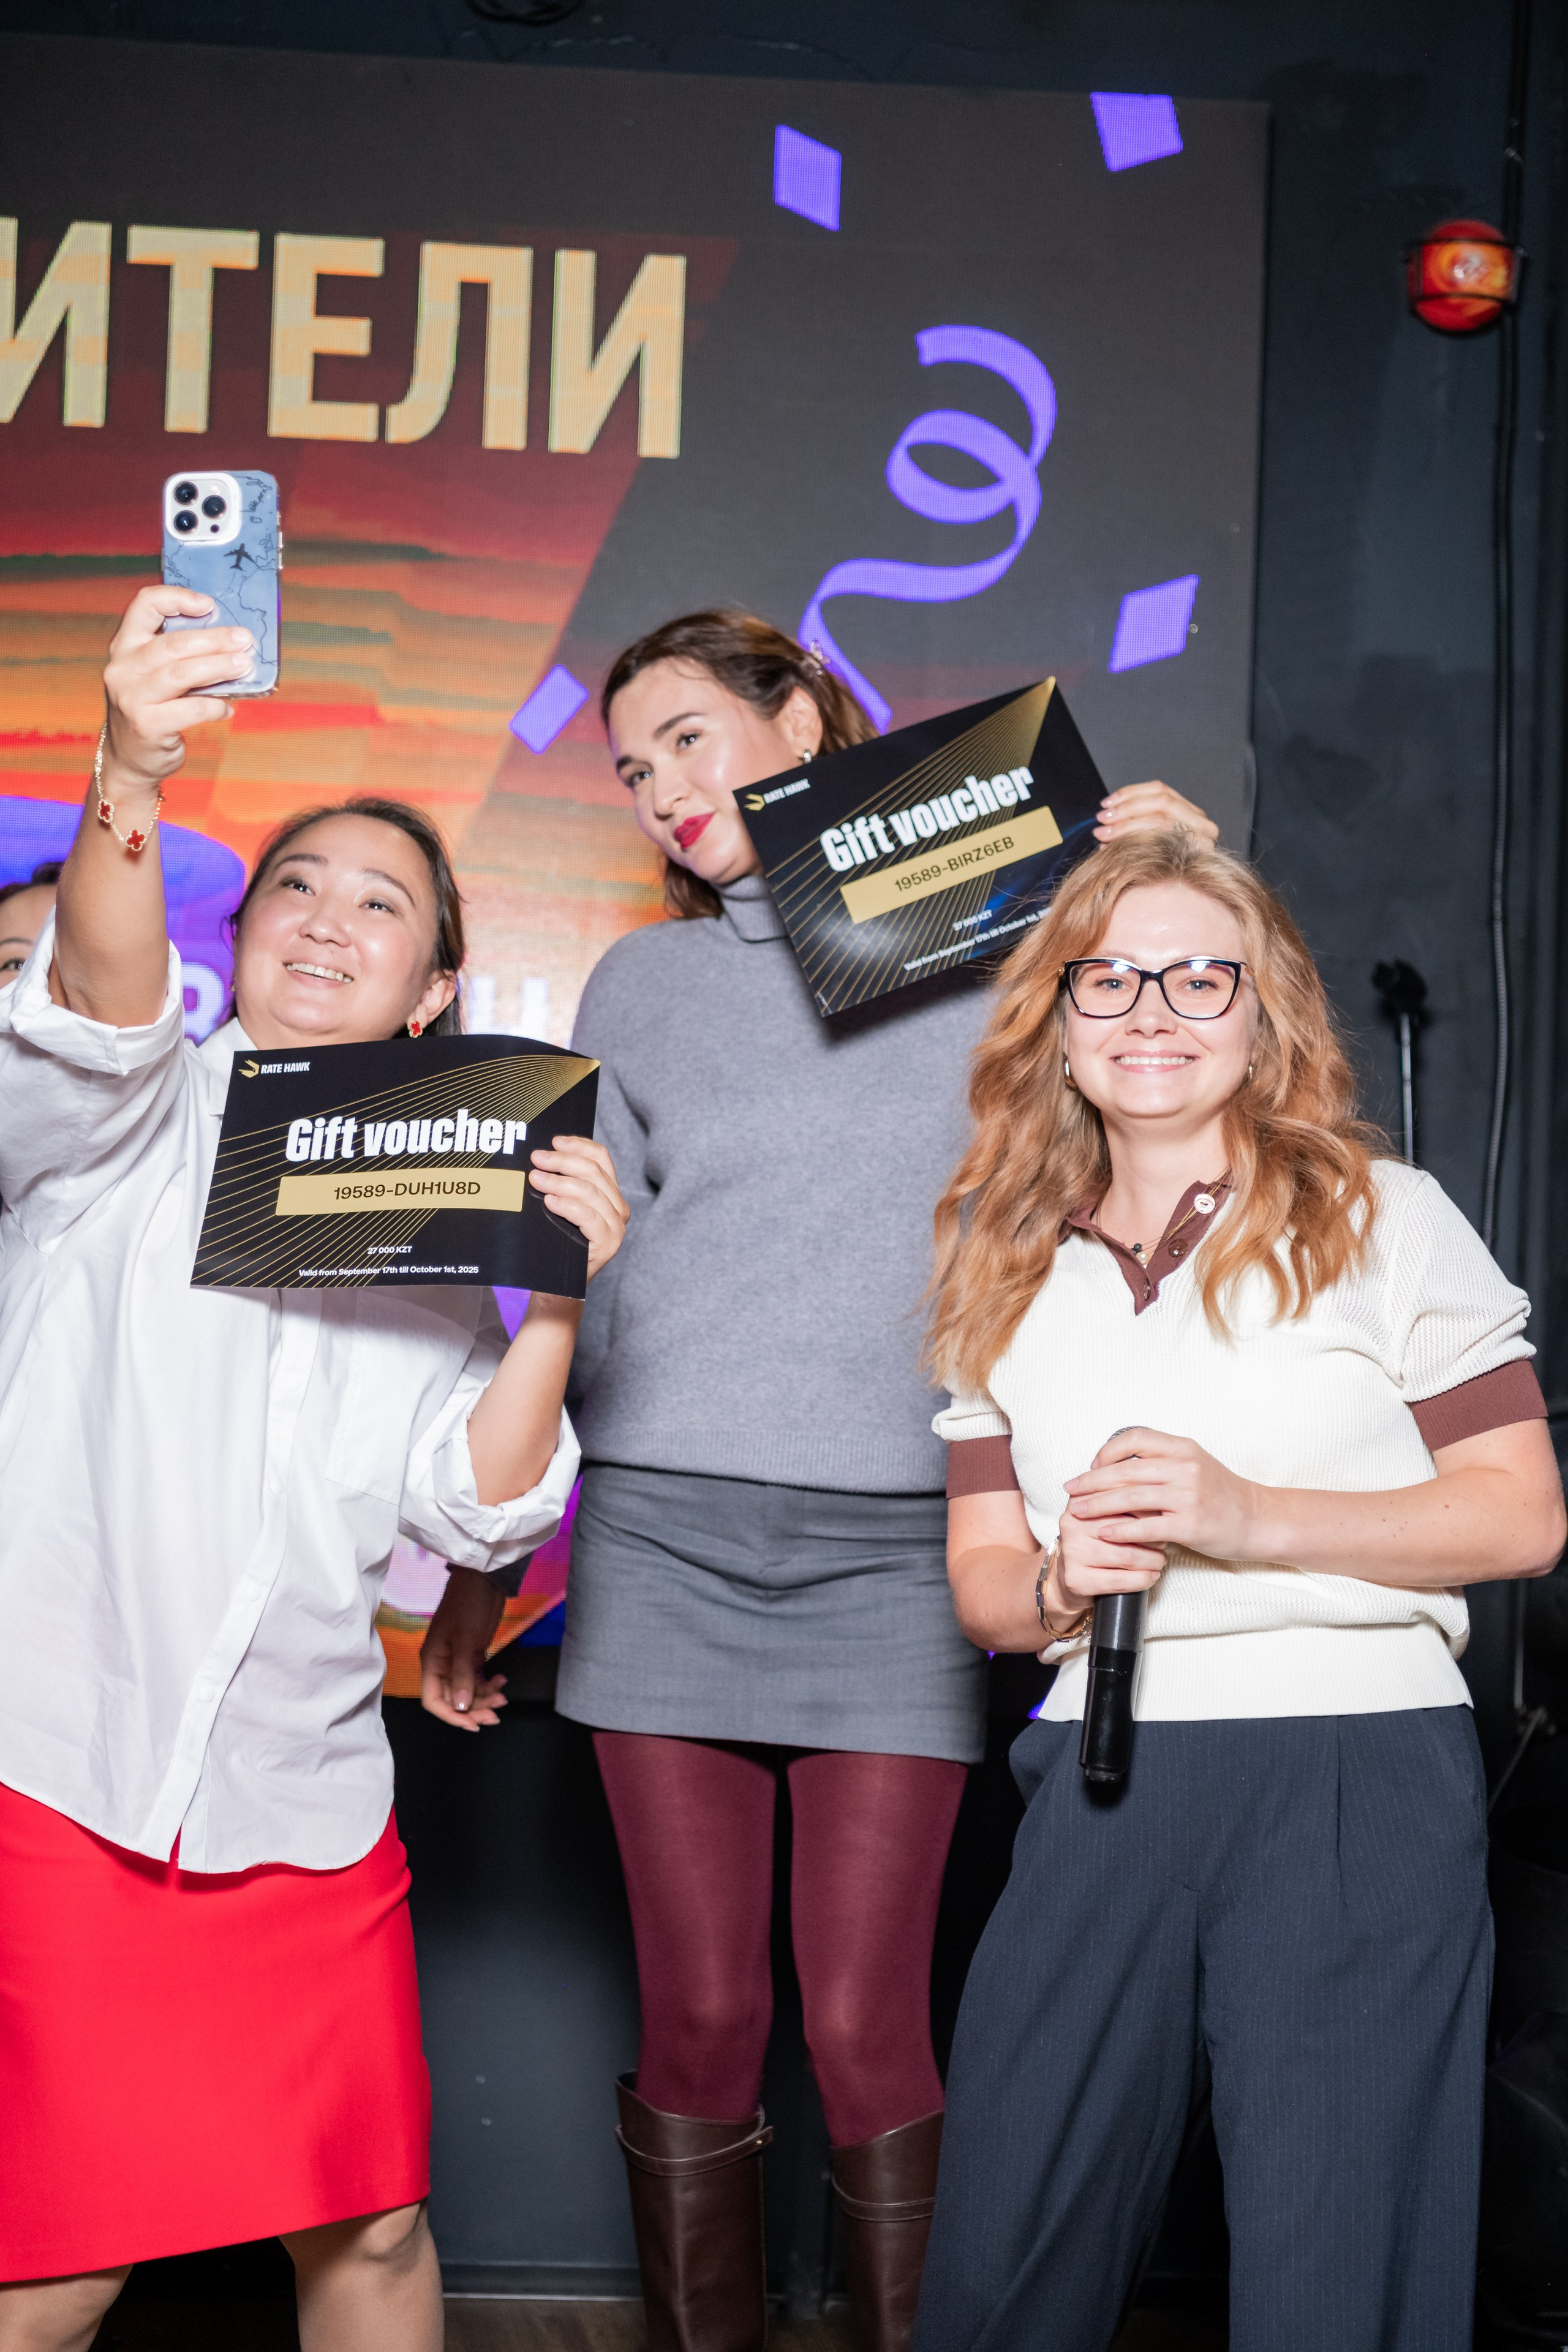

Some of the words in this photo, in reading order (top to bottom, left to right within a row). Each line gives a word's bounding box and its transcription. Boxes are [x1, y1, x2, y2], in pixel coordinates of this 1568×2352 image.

[820, 813, 895, 872] Gift
[888, 766, 1034, 846] voucher
[894, 837, 1014, 892] 19589-BIRZ6EB
[903, 959, 922, 971] Valid
[921, 953, 939, 965] from
[938, 939, 976, 957] September
[999, 919, 1026, 934] October
[260, 1064, 282, 1074] RATE
[284, 1061, 311, 1073] HAWK
[285, 1116, 358, 1162] Gift
[364, 1109, 527, 1156] voucher
[334, 1181, 481, 1200] 19589-DUH1U8D
[443, 1266, 457, 1275] 1st,
